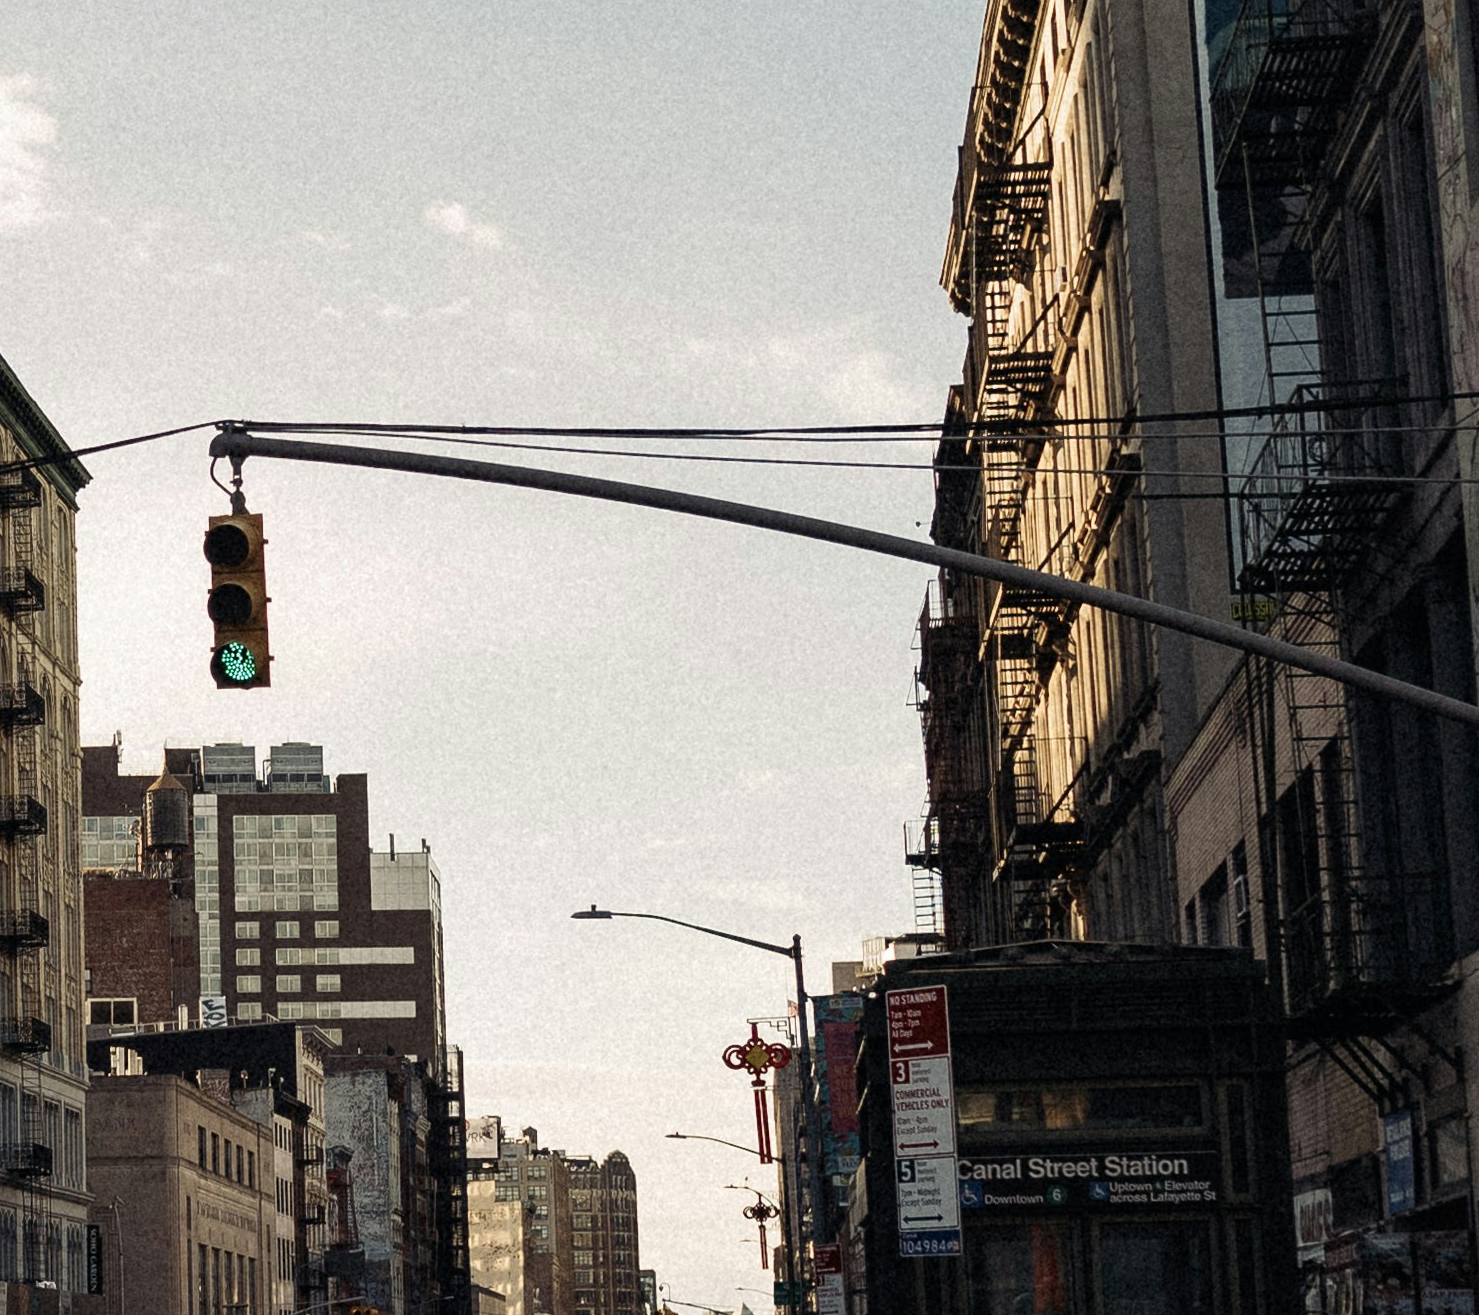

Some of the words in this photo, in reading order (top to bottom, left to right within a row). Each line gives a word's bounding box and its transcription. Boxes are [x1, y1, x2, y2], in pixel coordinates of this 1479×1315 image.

[889, 994, 900, 1006] NO
[901, 991, 937, 1005] STANDING
[896, 1062, 906, 1083] 3
[895, 1087, 940, 1100] COMMERCIAL
[896, 1100, 929, 1112] VEHICLES
[931, 1099, 949, 1109] ONLY
[900, 1161, 912, 1181] 5
[958, 1159, 1021, 1180] Canal
[1028, 1157, 1098, 1178] Street
[1104, 1155, 1188, 1177] Station
[1109, 1182, 1152, 1194] Uptown
[1165, 1180, 1211, 1191] Elevator
[985, 1193, 1044, 1205] Downtown
[1110, 1193, 1147, 1203] across
[1150, 1191, 1201, 1204] Lafayette
[1204, 1191, 1216, 1202] St
[90, 1227, 98, 1254] SOHO
[902, 1239, 947, 1254] 104984
